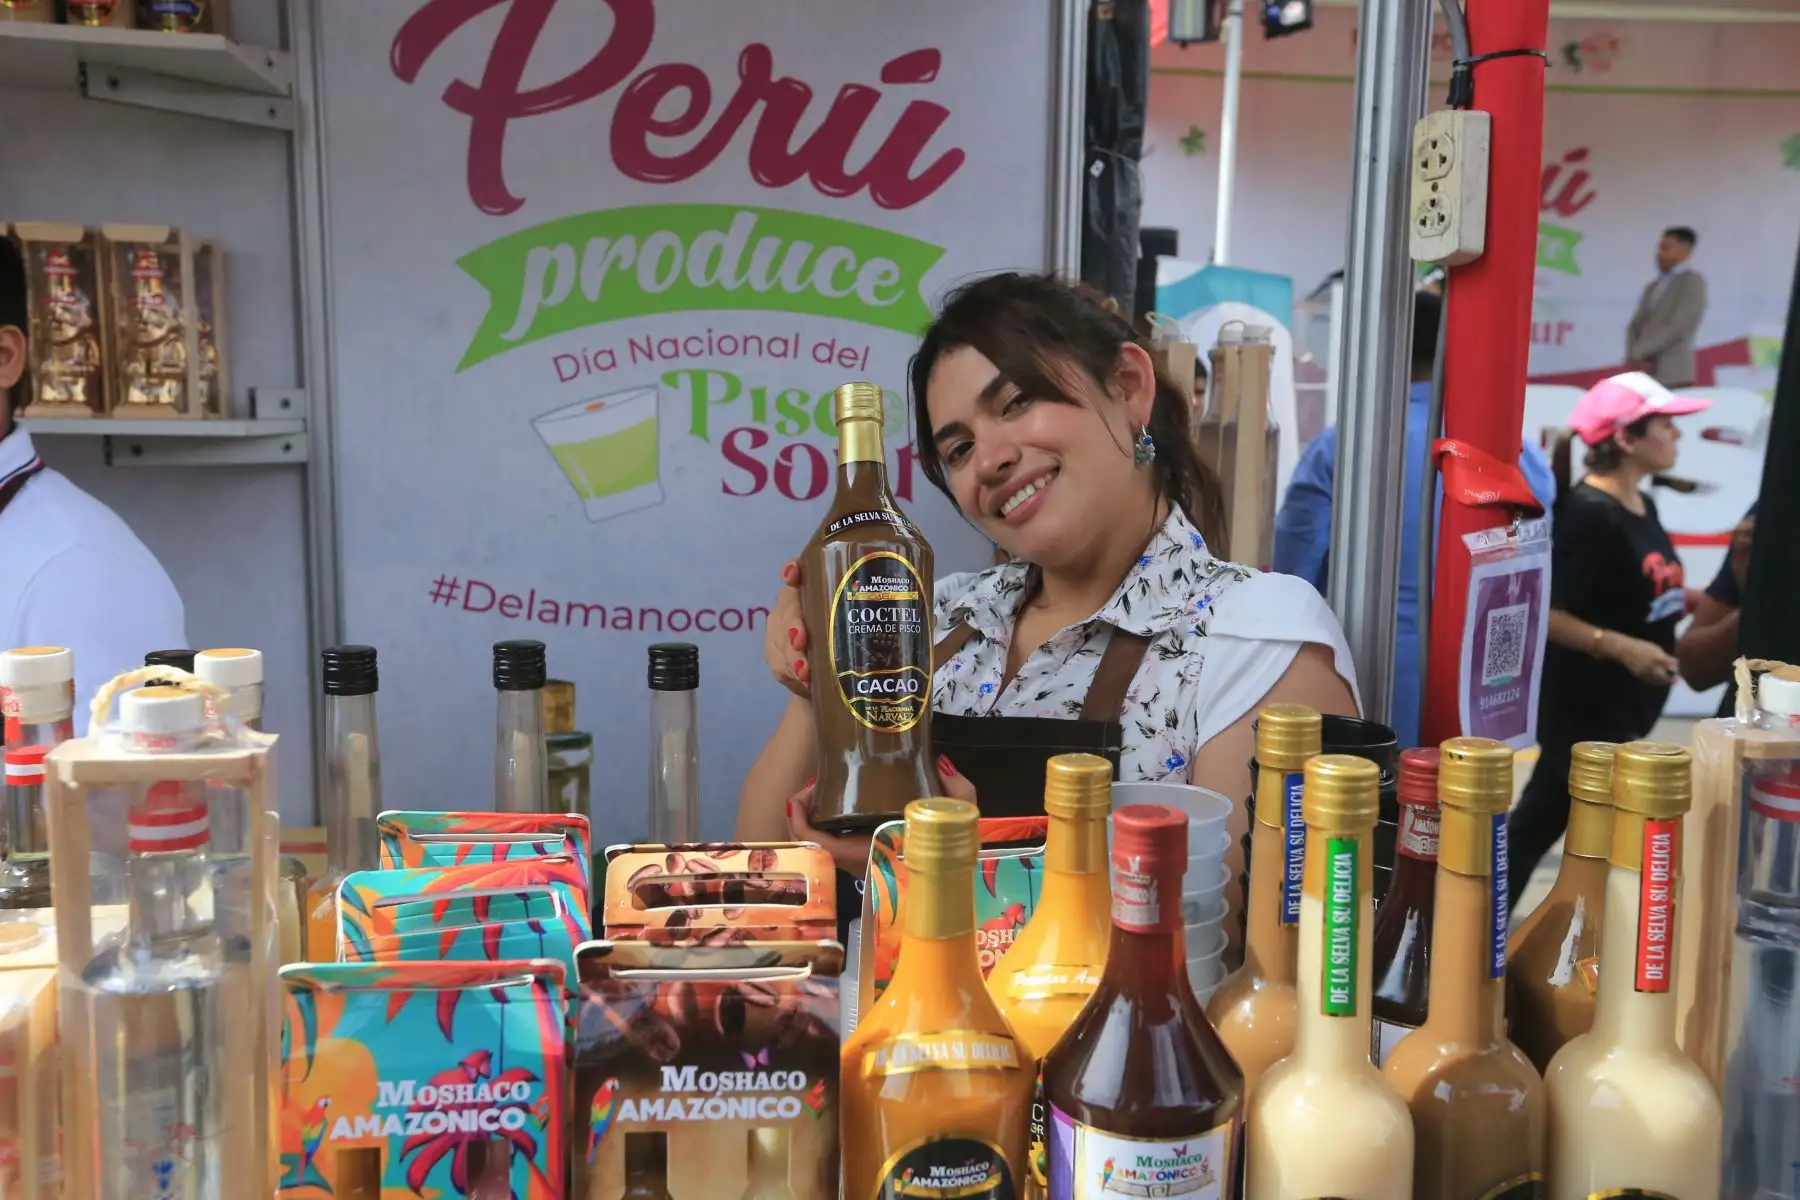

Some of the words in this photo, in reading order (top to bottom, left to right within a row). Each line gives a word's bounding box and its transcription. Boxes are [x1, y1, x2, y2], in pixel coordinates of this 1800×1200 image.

[389, 0, 965, 215] Perú
[499, 209, 907, 342] produce
[553, 346, 617, 383] Día
[628, 328, 800, 364] Nacional
[811, 338, 871, 372] del
[721, 427, 920, 502] Sor
[830, 521, 841, 532] DE
[842, 517, 854, 526] LA
[854, 511, 881, 522] SELVA
[429, 574, 770, 632] #Delamanocon
[847, 607, 920, 624] COCTEL
[849, 624, 882, 634] CREMA
[885, 624, 897, 633] DE
[900, 624, 920, 633] PISCO
[857, 679, 918, 693] CACAO
[1290, 784, 1305, 828] DELICIA
[1290, 829, 1305, 845] SU
[1496, 823, 1508, 871] DELICIA
[1289, 849, 1305, 881] SELVA
[1651, 833, 1672, 881] DELICIA
[1333, 853, 1352, 903] DELICIA
[1497, 873, 1508, 891] SU
[1649, 885, 1668, 901] SU
[1332, 906, 1351, 924] SU
[1496, 893, 1507, 932] SELVA
[1648, 905, 1667, 941] SELVA
[1331, 927, 1350, 964] SELVA
[1646, 945, 1665, 959] LA
[1331, 968, 1349, 983] LA
[1645, 963, 1664, 979] DE
[1330, 986, 1349, 1003] DE
[660, 1066, 807, 1092] MOSHACO
[377, 1080, 531, 1108] MOSHACO
[616, 1091, 802, 1122] AMAZÓNICO
[329, 1103, 526, 1140] AMAZÓNICO
[930, 1161, 990, 1177] MOSHACO
[1136, 1153, 1203, 1168] MOSHACO
[912, 1173, 987, 1188] AMAZÓNICO
[1117, 1168, 1197, 1181] AMAZÓNICO
